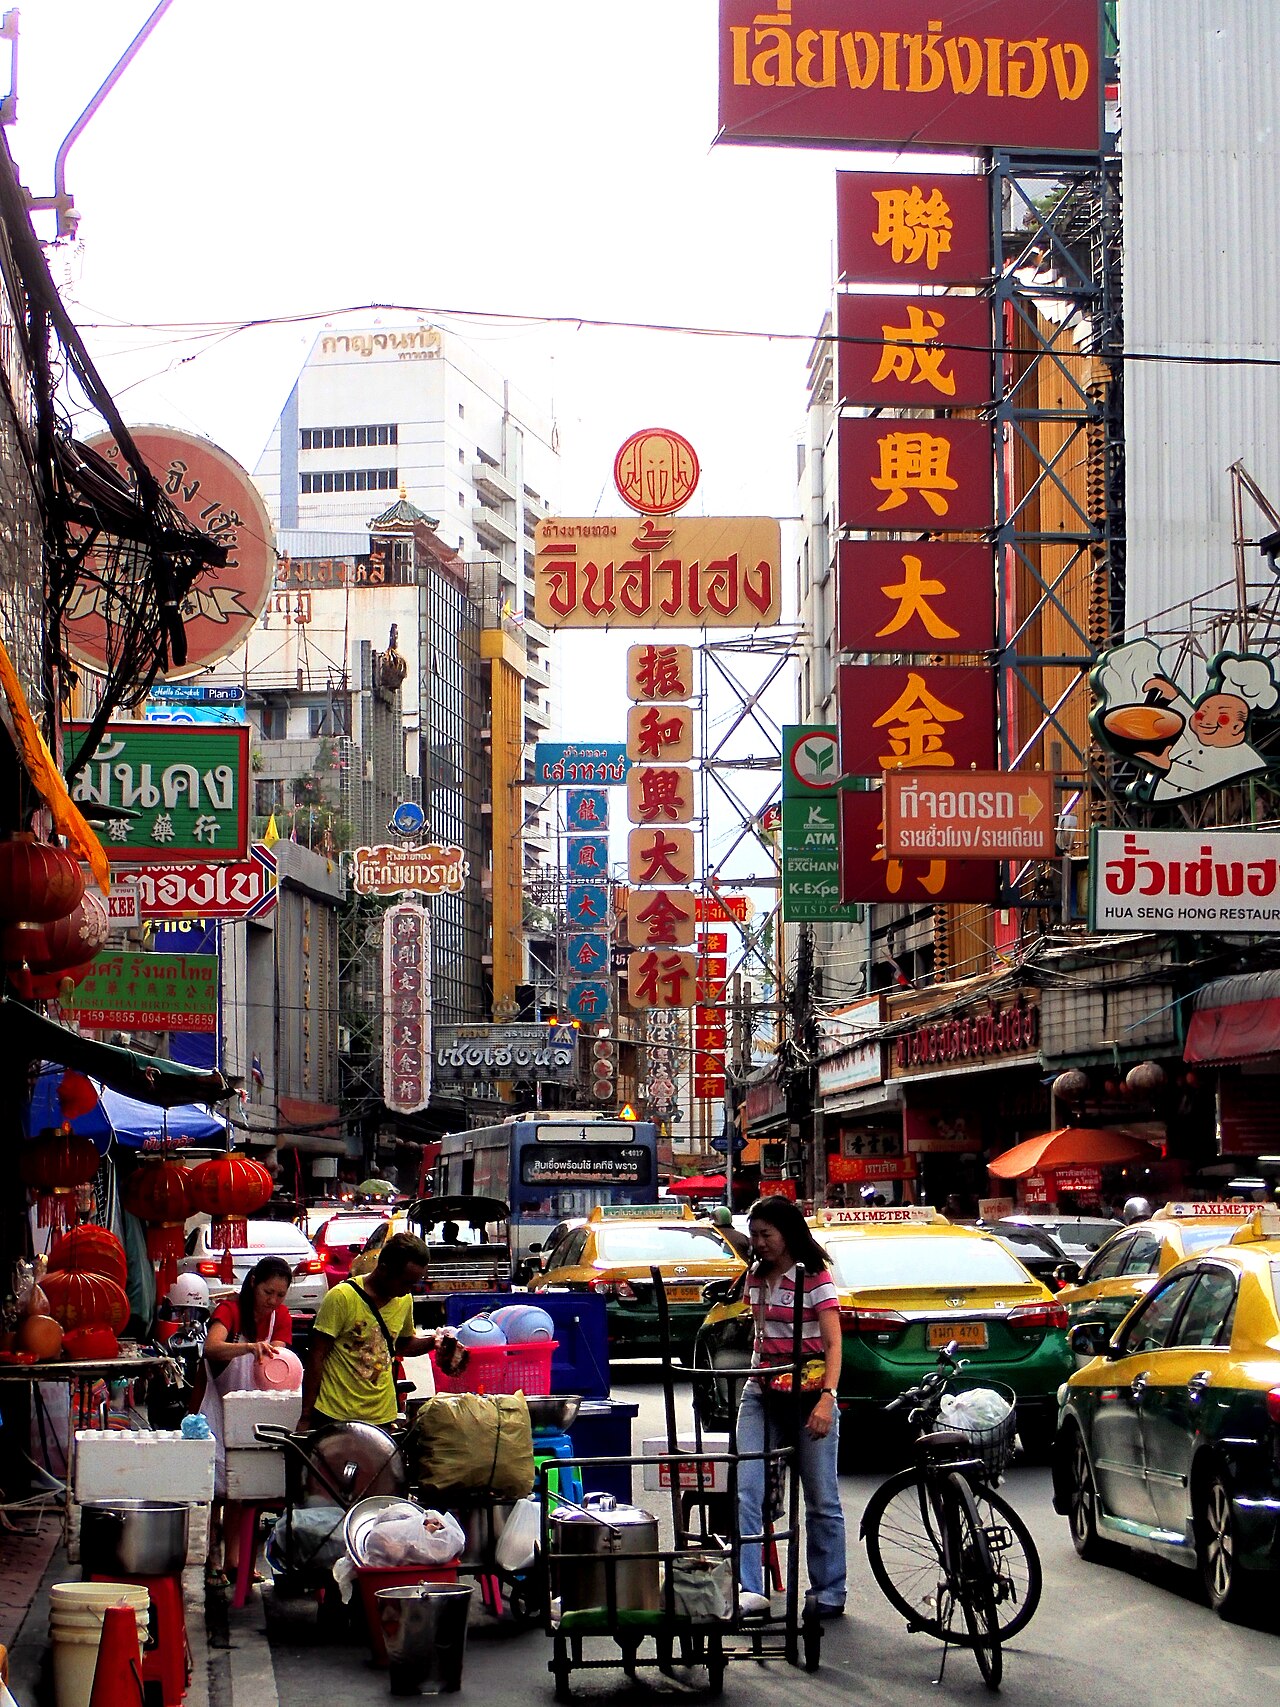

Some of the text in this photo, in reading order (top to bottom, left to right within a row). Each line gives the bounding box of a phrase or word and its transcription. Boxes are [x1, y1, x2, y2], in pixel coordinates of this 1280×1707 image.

[729, 0, 1089, 100] เลี่ยงเซ่งเฮง
[542, 520, 617, 537] ห้างขายทอง
[871, 185, 964, 894] 聯成興大金
[900, 778, 1014, 819] ที่จอดรถ
[104, 812, 222, 845] 發藥行
[804, 833, 836, 845] ATM
[1105, 834, 1280, 897] ฮั่วเซ่งฮ
[789, 880, 838, 898] K-Expe
[108, 897, 135, 917] KEE
[790, 906, 851, 915] WISDOM
[1105, 907, 1280, 920] HUA SENG HONG RESTAUR
[579, 1127, 587, 1140] 4
[837, 1210, 912, 1221] TAXI-METER
